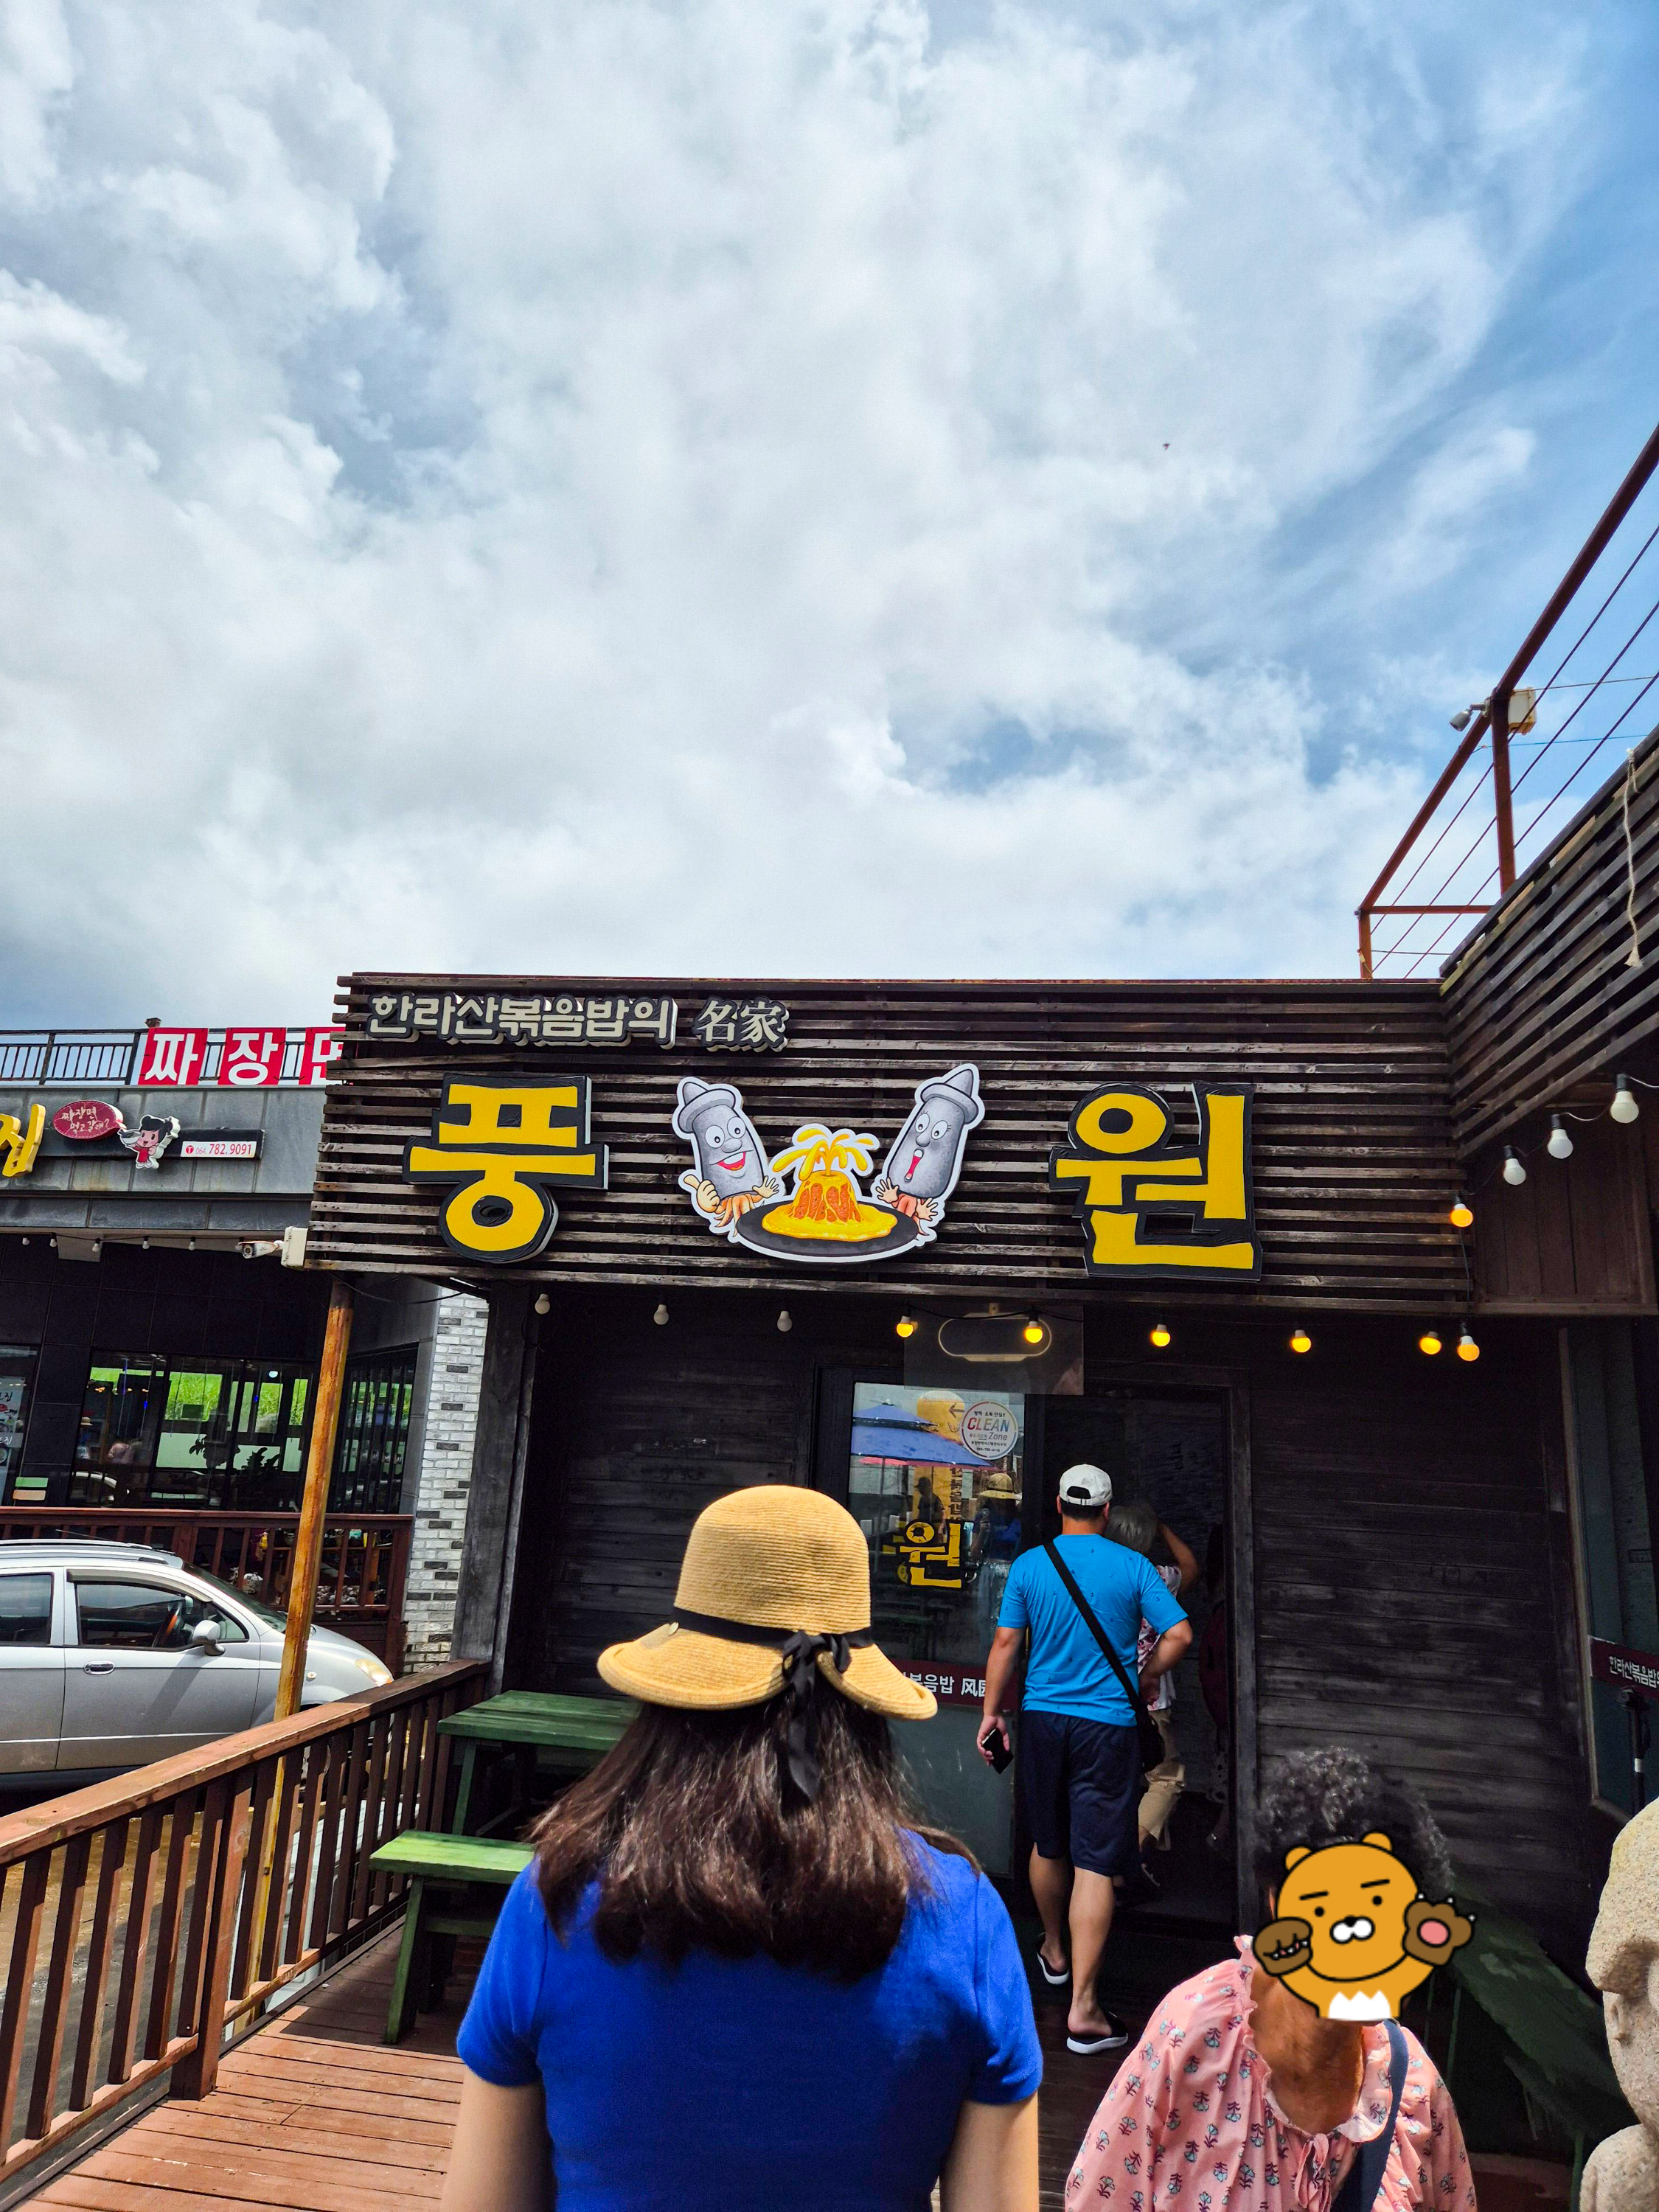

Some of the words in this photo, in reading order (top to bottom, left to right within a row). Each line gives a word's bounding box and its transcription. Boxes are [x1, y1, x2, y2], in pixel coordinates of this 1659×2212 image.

[369, 995, 669, 1039] 한라산볶음밥의
[697, 1000, 785, 1044] 名家
[71, 1121, 86, 1134] 먹고
[87, 1119, 110, 1133] 갈래?
[410, 1083, 596, 1251] 풍
[1056, 1093, 1253, 1269] 원
[967, 1416, 1010, 1432] CLEAN
[988, 1432, 1008, 1441] Zone
[899, 1521, 962, 1588] 원
